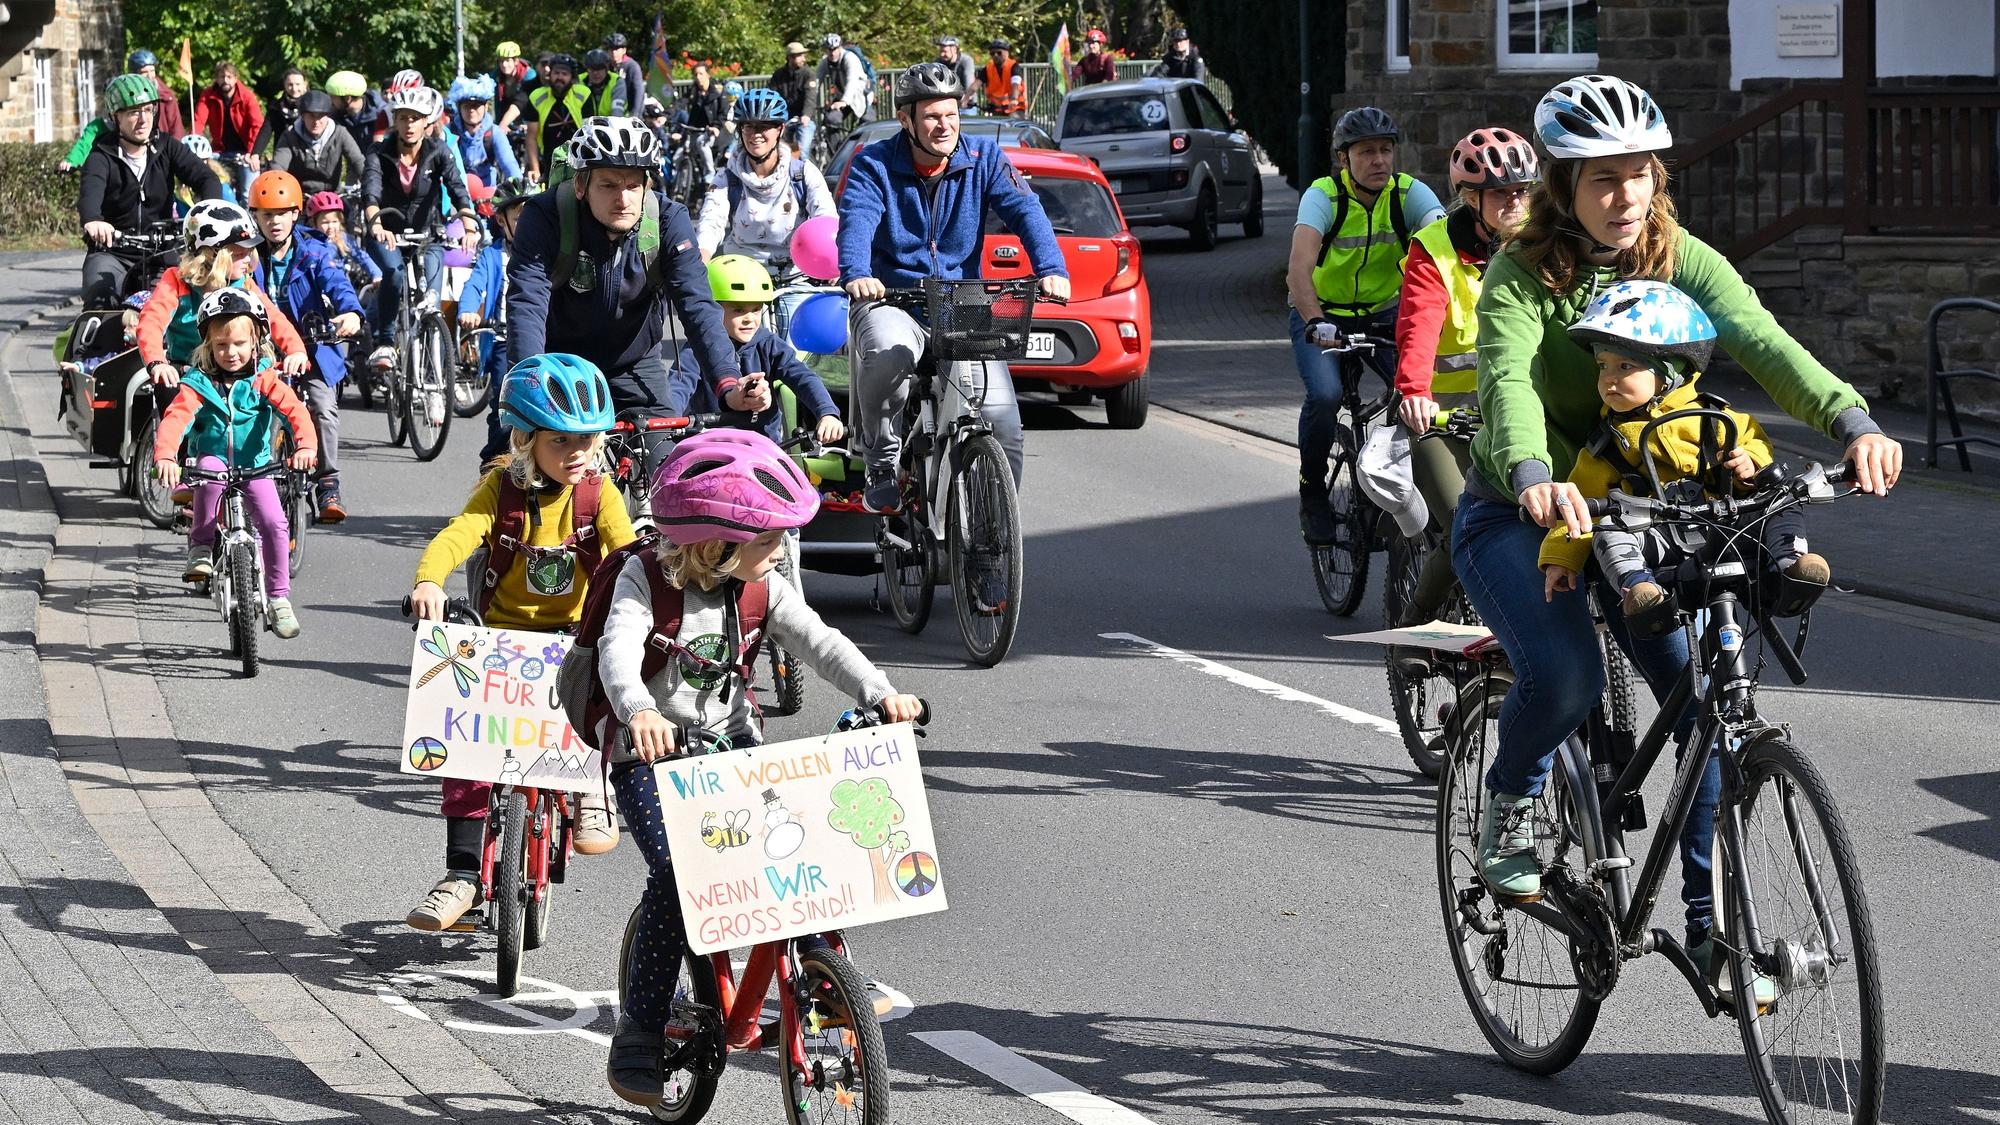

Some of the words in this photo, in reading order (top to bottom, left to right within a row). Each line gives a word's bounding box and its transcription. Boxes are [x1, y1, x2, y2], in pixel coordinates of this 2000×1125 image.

[997, 248, 1015, 257] KIA
[483, 669, 536, 707] FÜR
[444, 707, 586, 753] KINDER
[734, 751, 832, 788] WOLLEN
[843, 739, 903, 772] AUCH
[687, 876, 760, 912] WENN
[699, 906, 782, 946] GROSS
